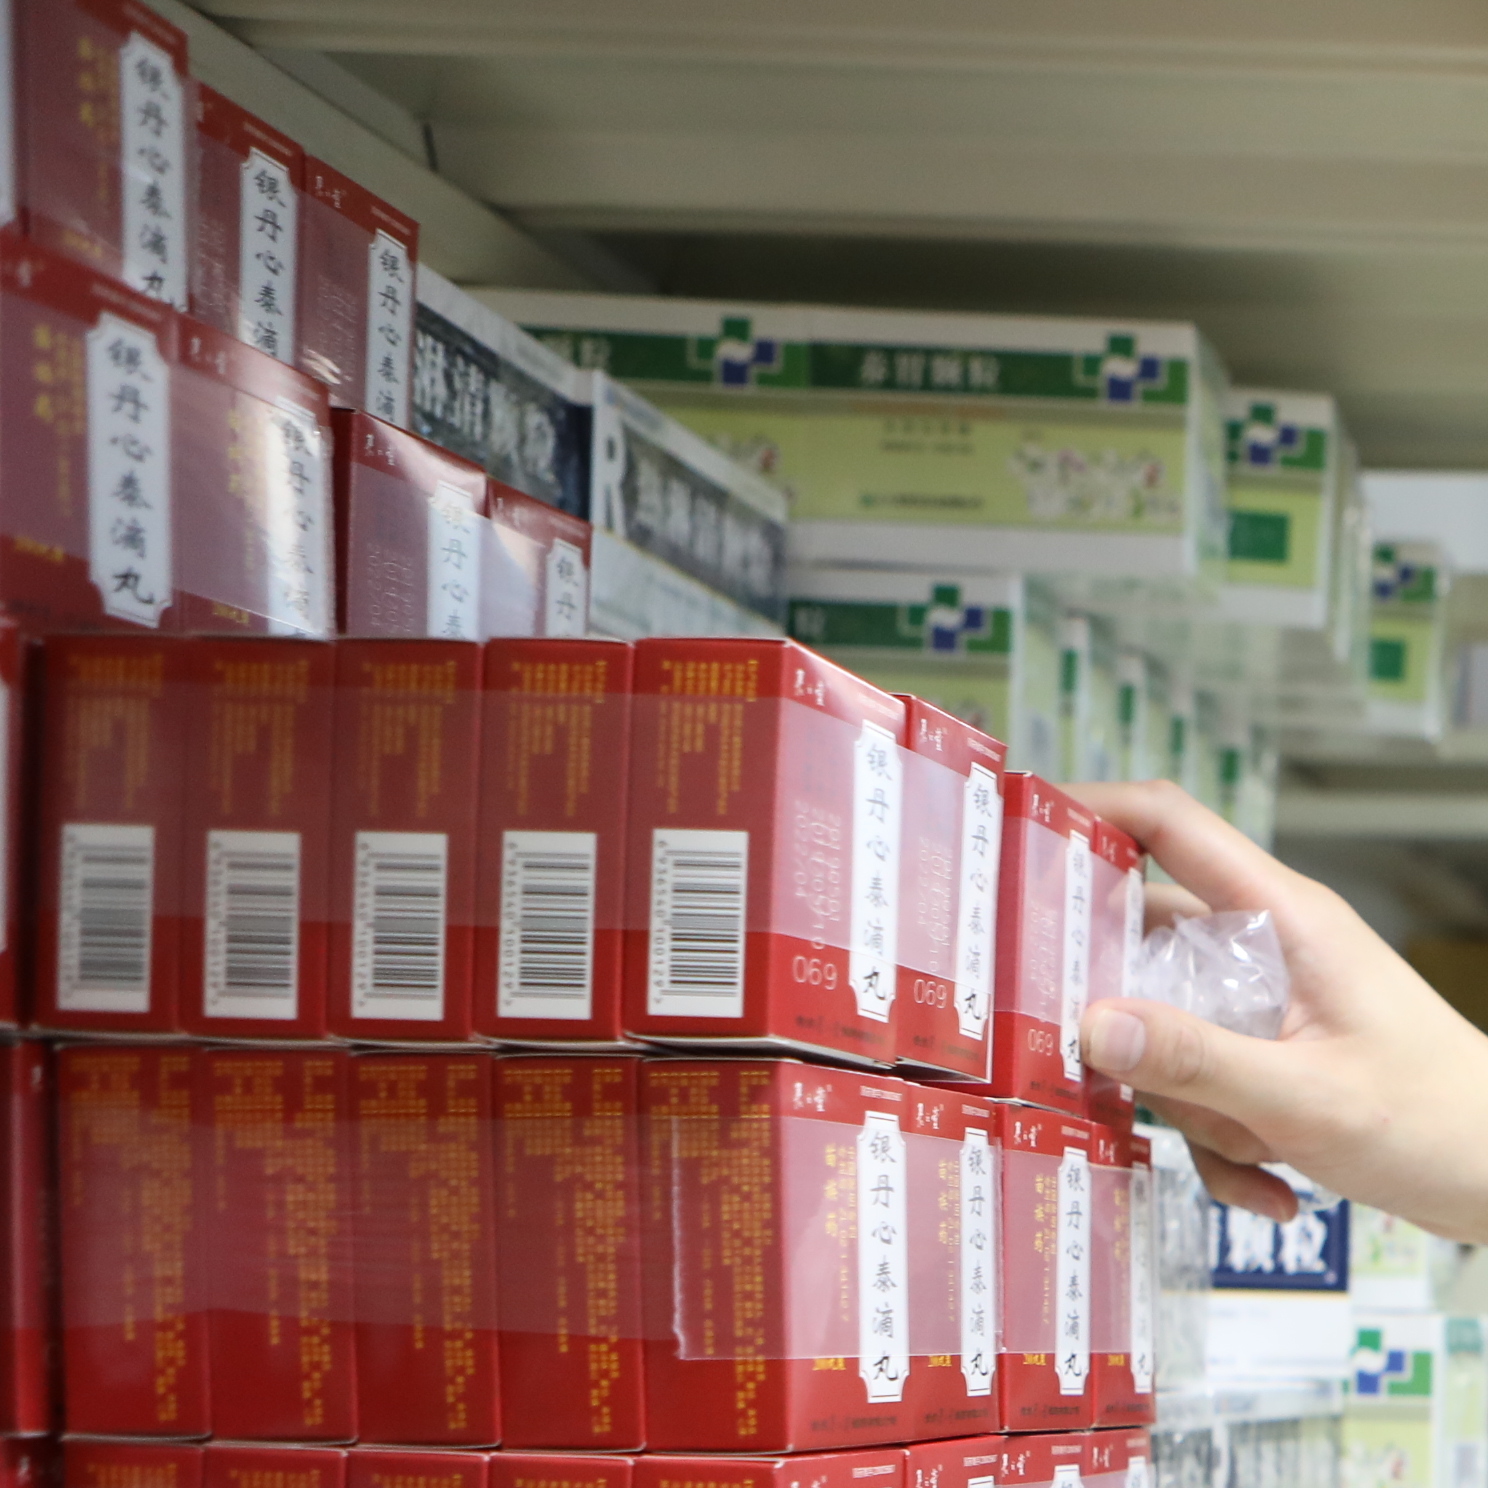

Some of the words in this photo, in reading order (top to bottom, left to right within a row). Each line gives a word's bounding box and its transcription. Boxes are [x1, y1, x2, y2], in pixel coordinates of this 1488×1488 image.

[107, 338, 158, 606] 银丹心泰滴丸
[792, 955, 838, 991] 069
[862, 746, 893, 1003] 银丹心泰滴丸
[962, 783, 993, 1023] 银丹心泰滴丸
[913, 978, 948, 1010] 069
[869, 1132, 899, 1382] 银丹心泰滴丸
[968, 1145, 989, 1378] 银丹心泰滴丸
[1064, 1165, 1085, 1378] 银丹心泰滴丸
